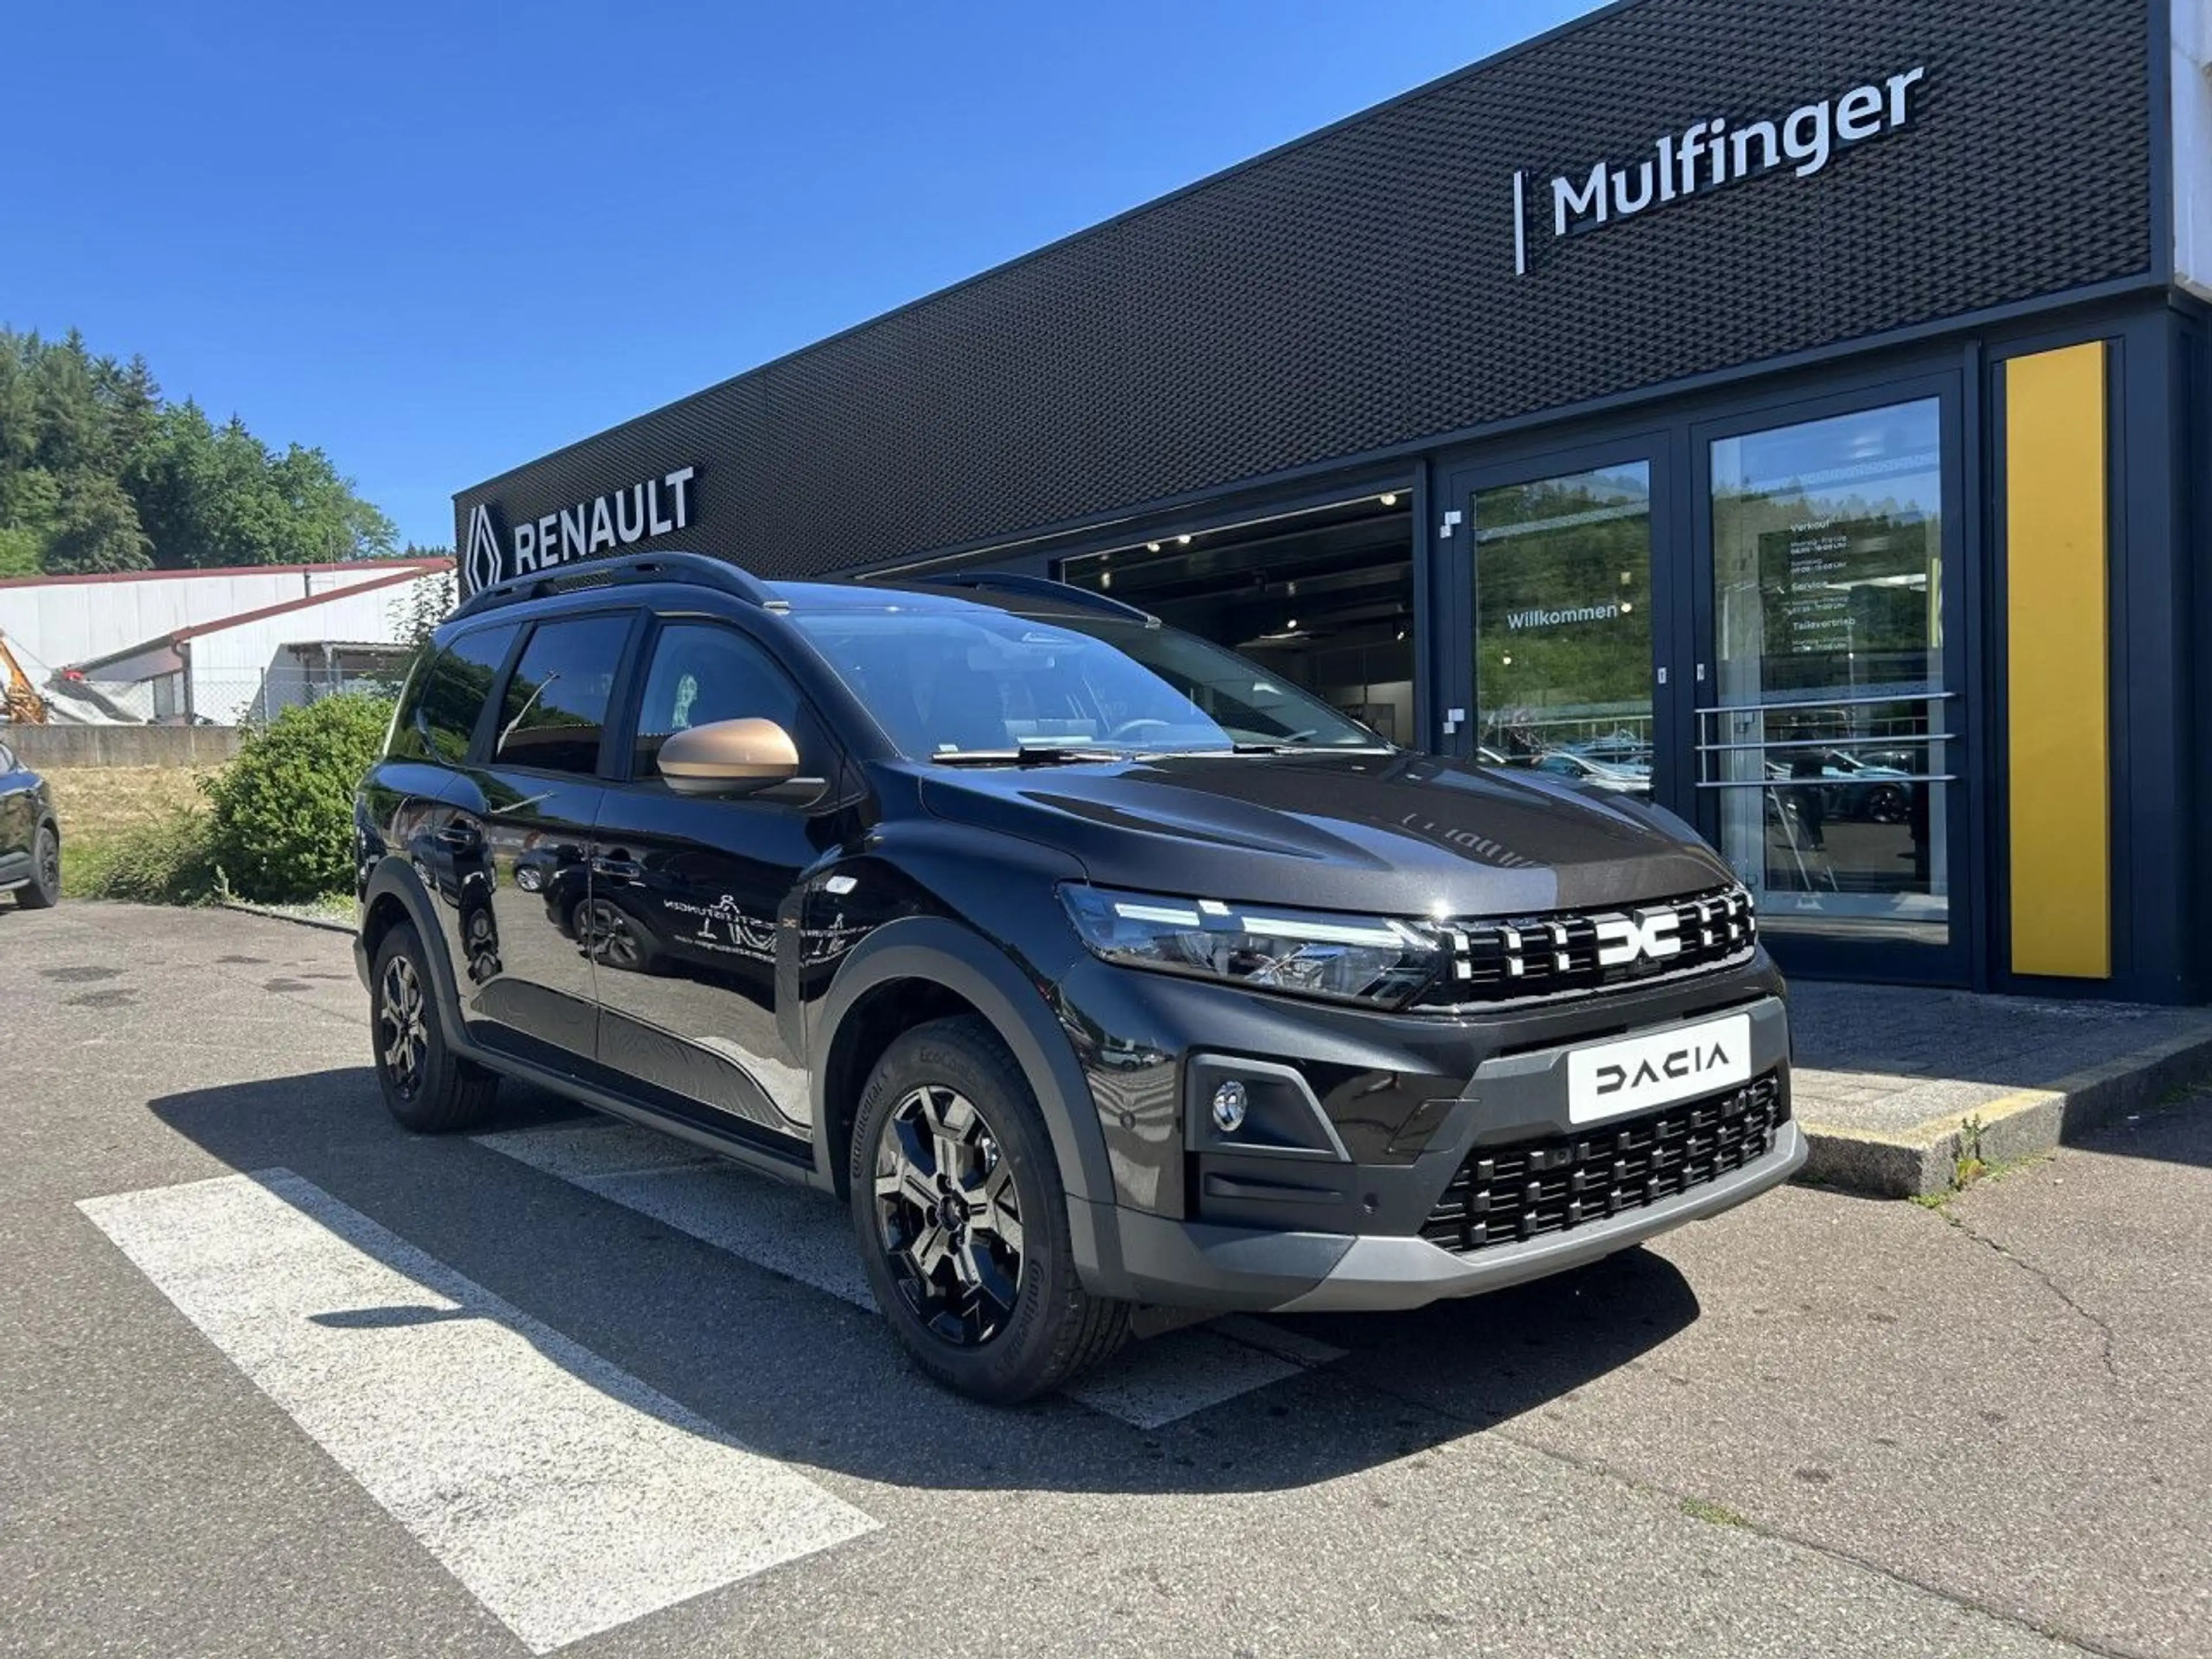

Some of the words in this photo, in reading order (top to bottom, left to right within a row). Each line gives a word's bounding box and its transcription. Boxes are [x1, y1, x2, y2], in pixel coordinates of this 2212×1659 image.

[1550, 66, 1924, 236] Mulfinger
[514, 466, 694, 575] RENAULT
[1507, 604, 1618, 629] Willkommen
[1596, 1042, 1729, 1095] DACIA
